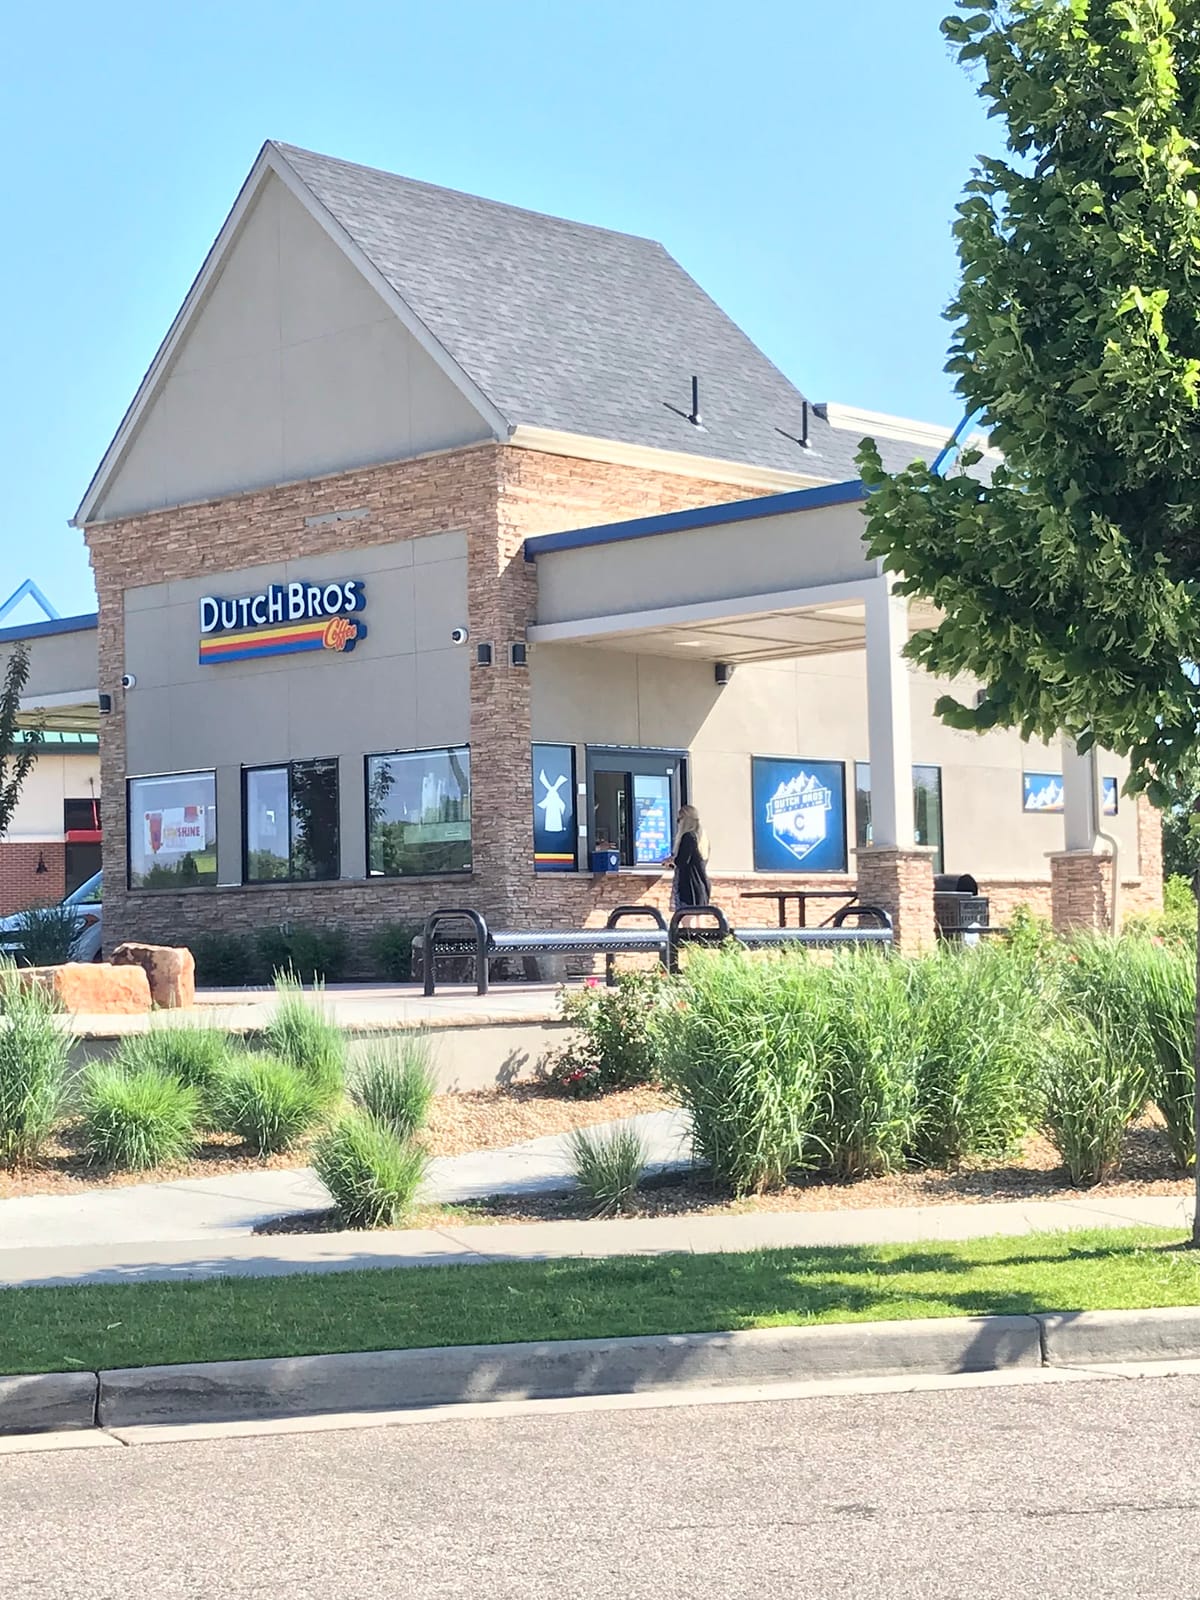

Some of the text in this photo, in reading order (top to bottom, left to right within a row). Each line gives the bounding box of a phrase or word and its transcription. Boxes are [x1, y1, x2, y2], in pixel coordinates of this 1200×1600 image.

[288, 581, 357, 620] BROS
[323, 616, 358, 650] Coffee
[794, 814, 805, 831] C
